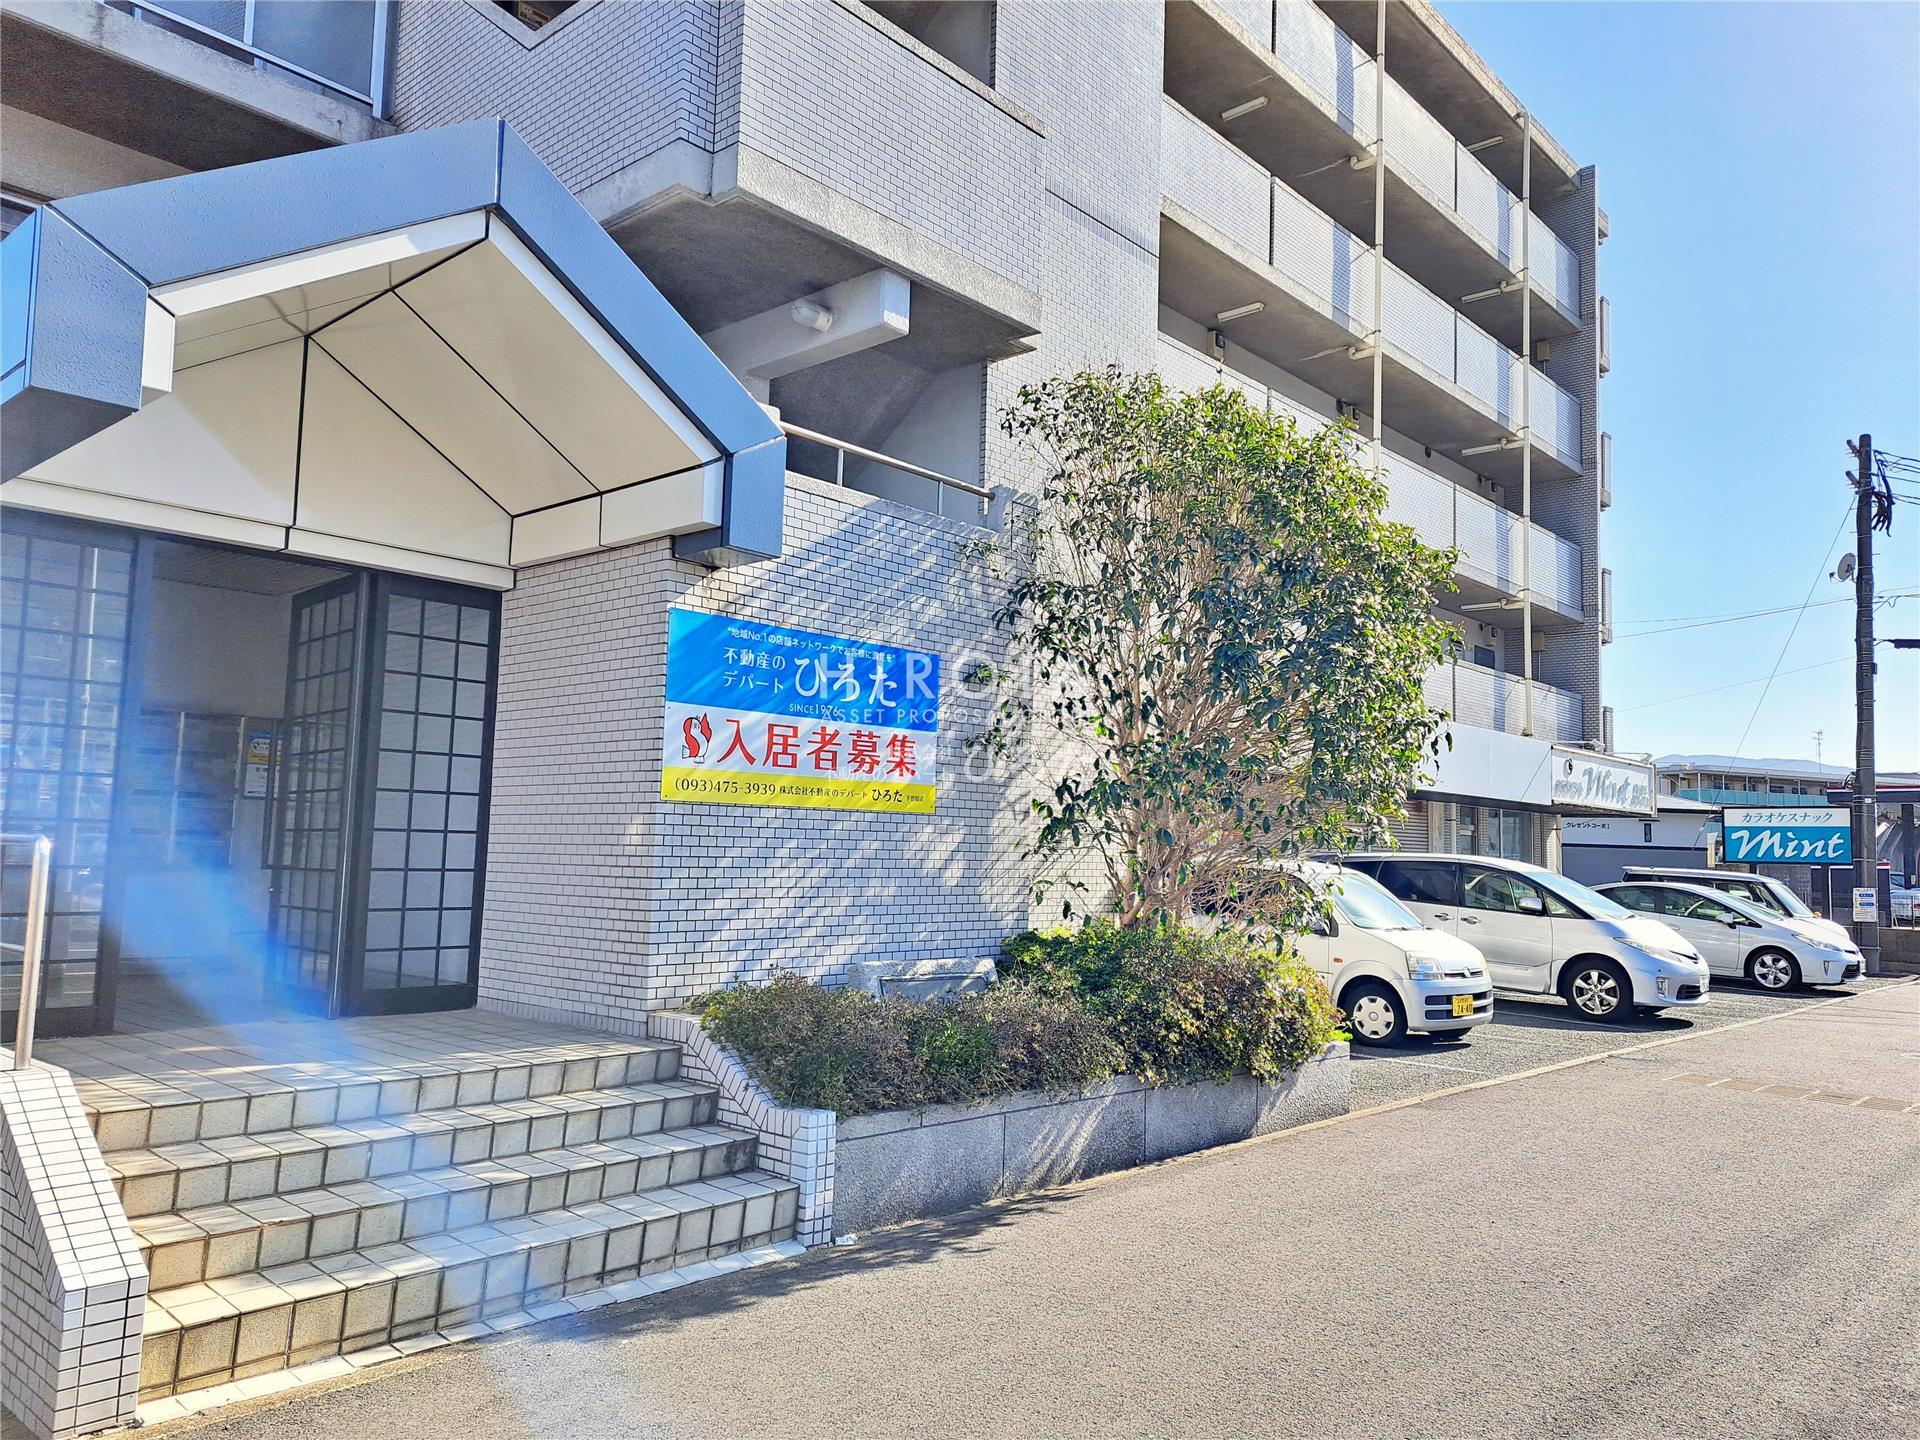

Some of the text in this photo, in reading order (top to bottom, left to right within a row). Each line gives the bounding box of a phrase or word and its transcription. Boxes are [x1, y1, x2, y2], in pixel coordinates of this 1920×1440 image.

[723, 647, 786, 671] 不動産の
[722, 670, 785, 694] デパート
[794, 656, 898, 708] ひろた
[716, 718, 917, 778] 入居者募集
[674, 777, 777, 797] (093)475-3939
[871, 788, 903, 804] ひろた
[1742, 812, 1833, 824] カラオケスナック
